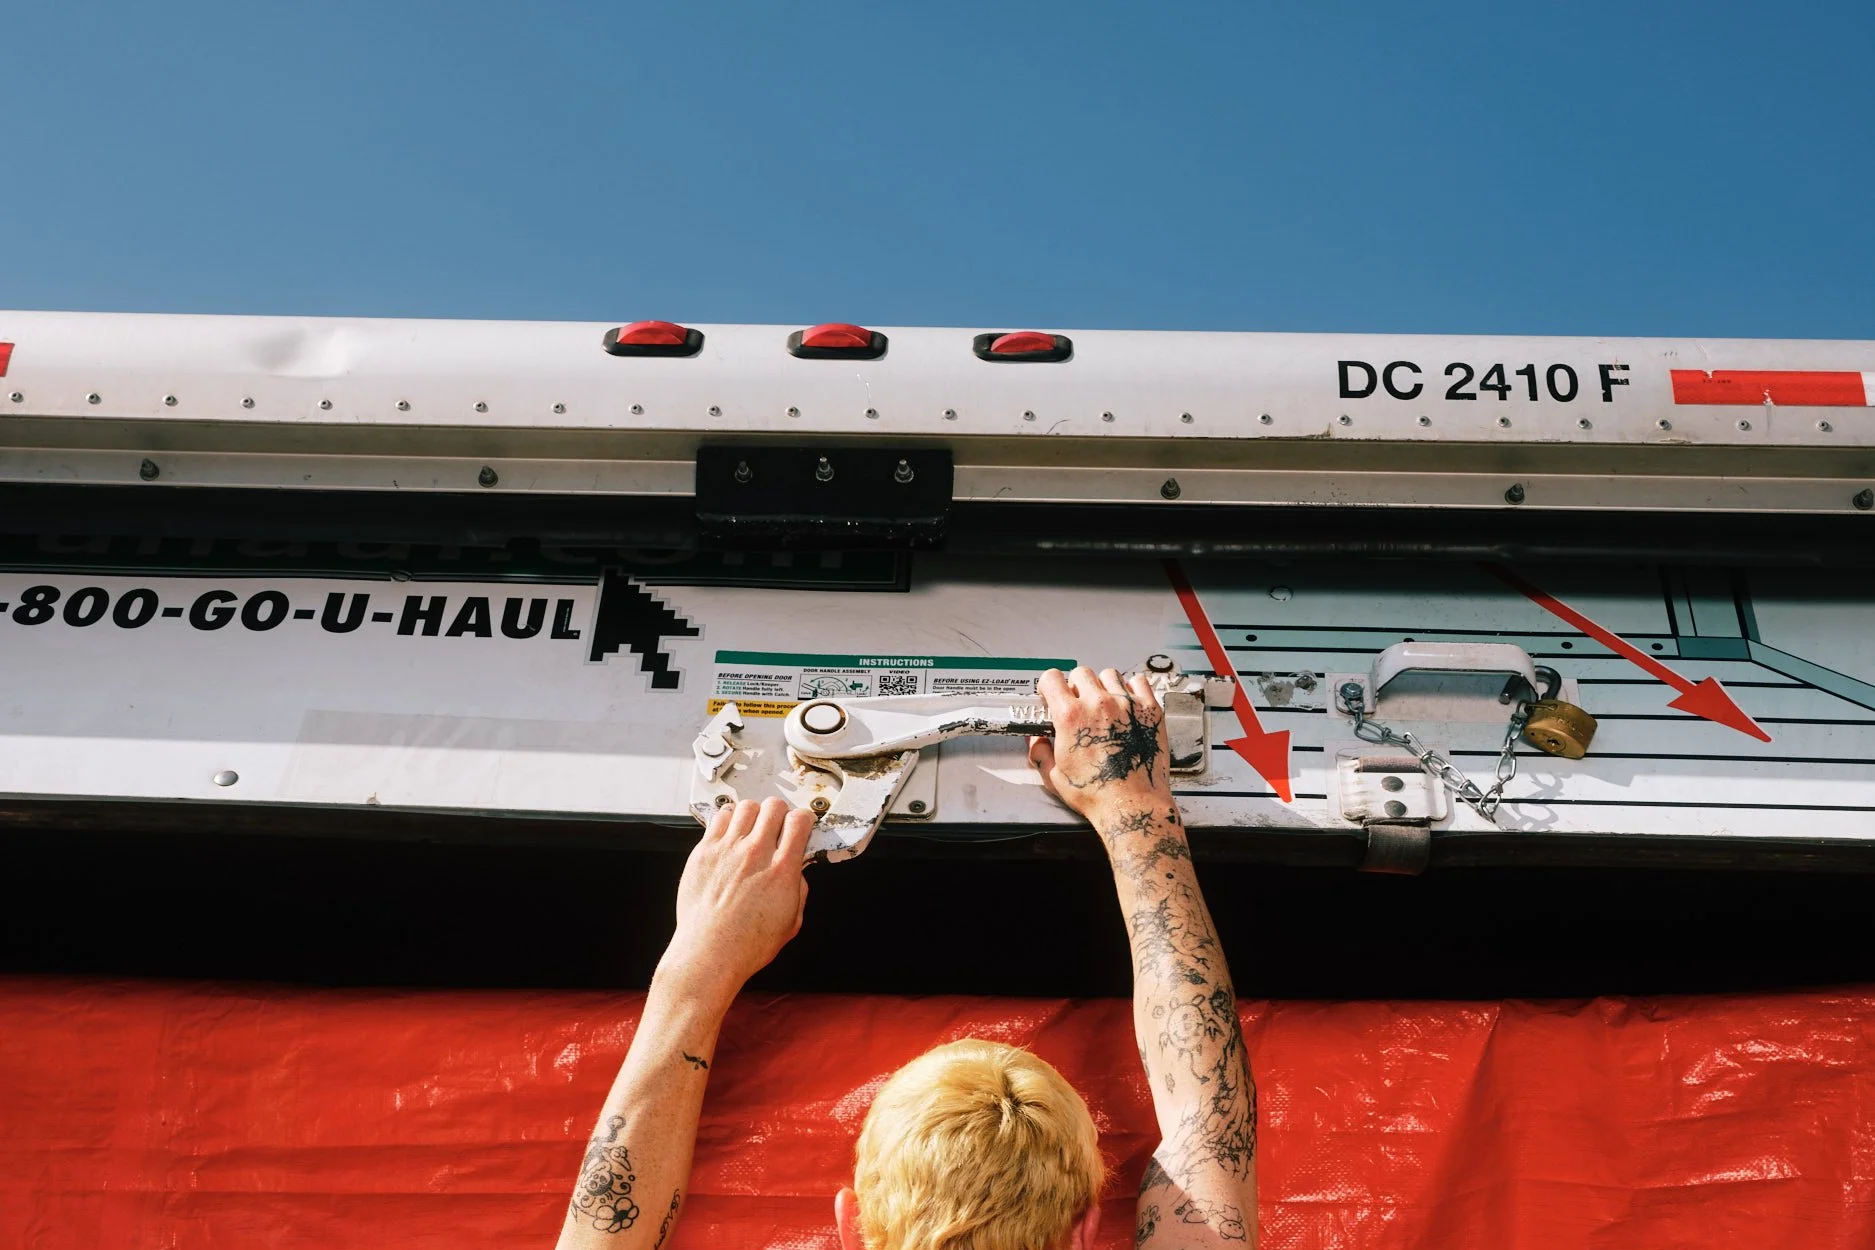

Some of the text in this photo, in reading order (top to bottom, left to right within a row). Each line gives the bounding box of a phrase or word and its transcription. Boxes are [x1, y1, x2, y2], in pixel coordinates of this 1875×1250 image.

[1337, 360, 1630, 403] DC 2410 F
[859, 658, 934, 667] INSTRUCTIONS
